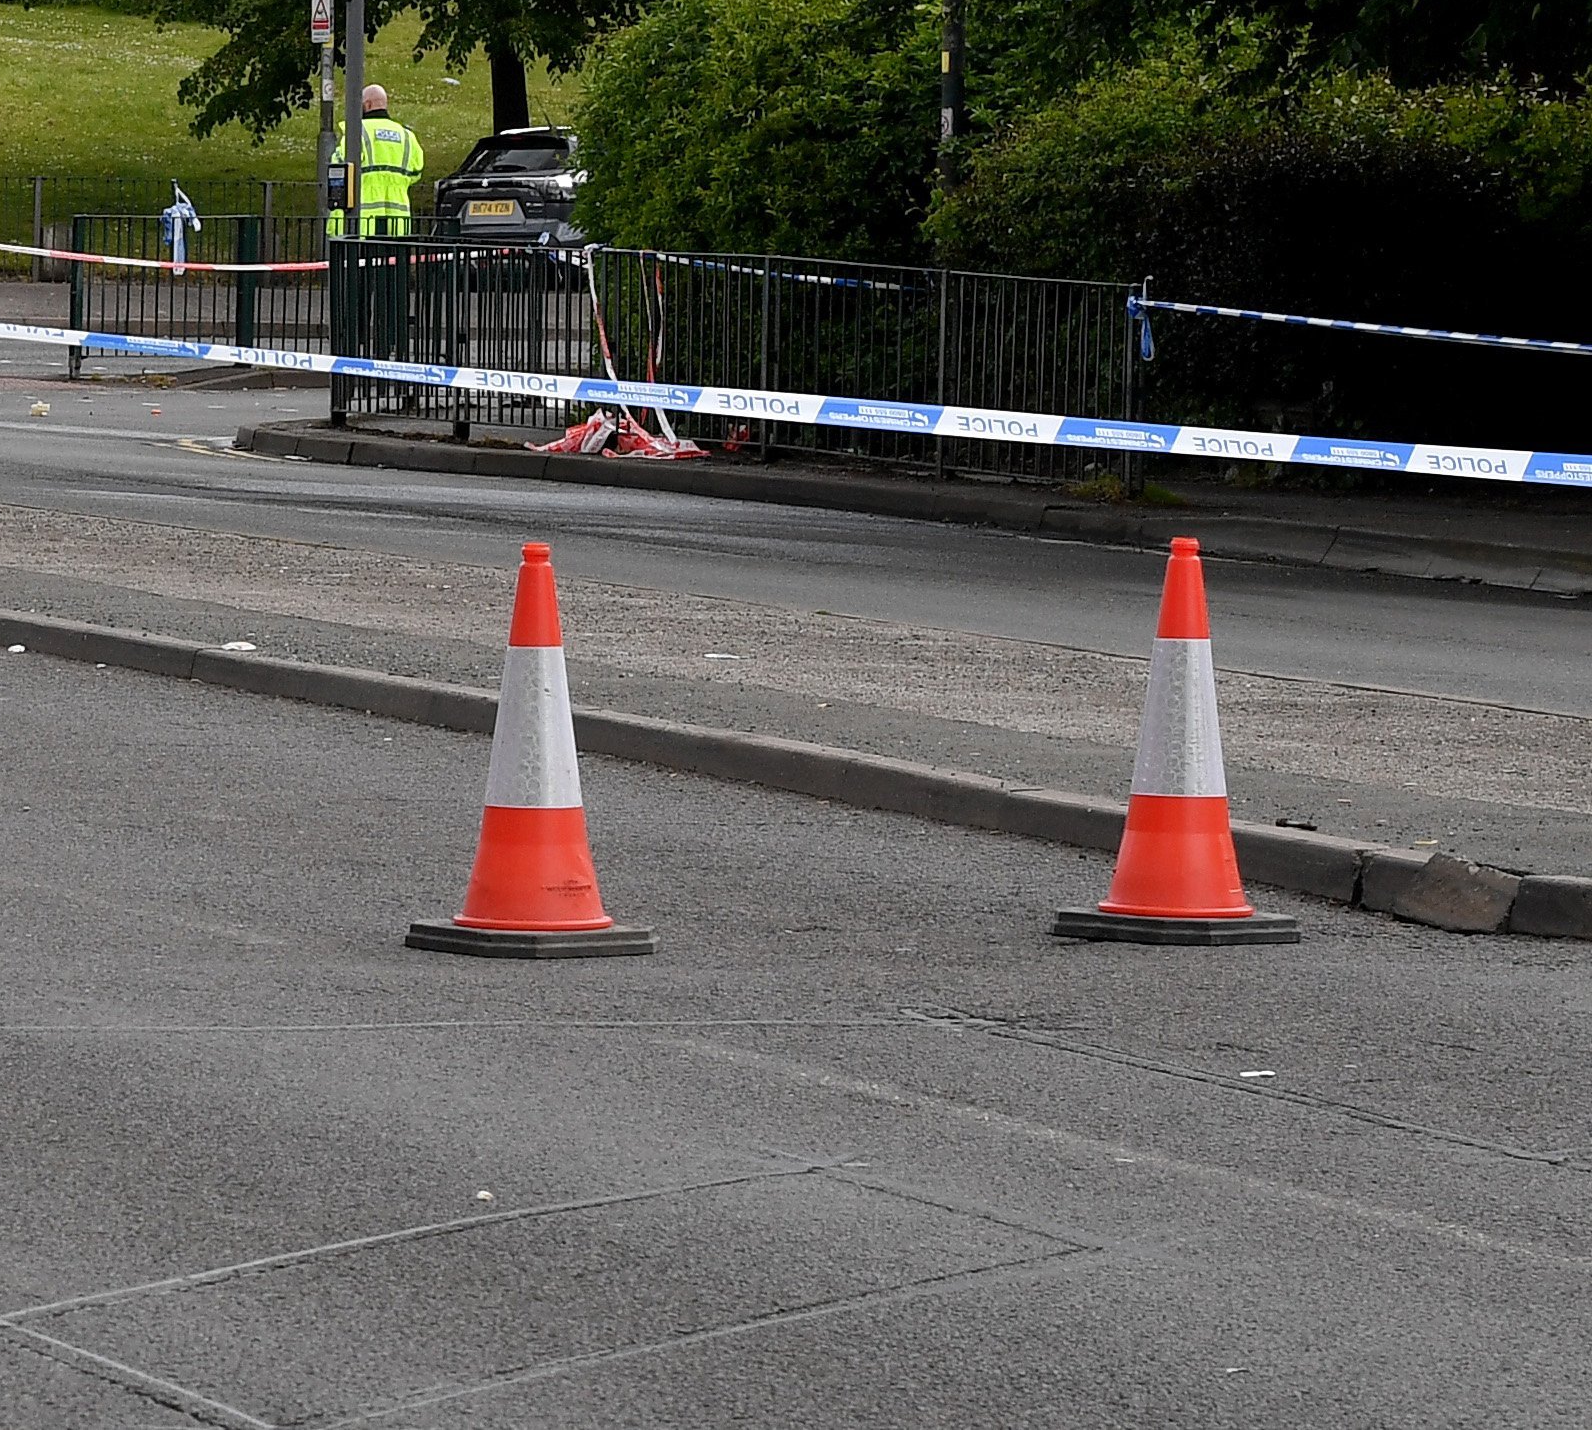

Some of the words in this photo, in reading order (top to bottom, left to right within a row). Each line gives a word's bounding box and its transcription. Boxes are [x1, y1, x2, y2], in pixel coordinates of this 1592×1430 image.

[474, 370, 558, 393] POLICE
[587, 389, 669, 405] CRIMESTOPPERS
[717, 393, 801, 416] POLICE
[829, 411, 911, 428] CRIMESTOPPERS
[956, 416, 1039, 438] POLICE
[1193, 436, 1274, 458] POLICE
[1426, 454, 1508, 475] POLICE
